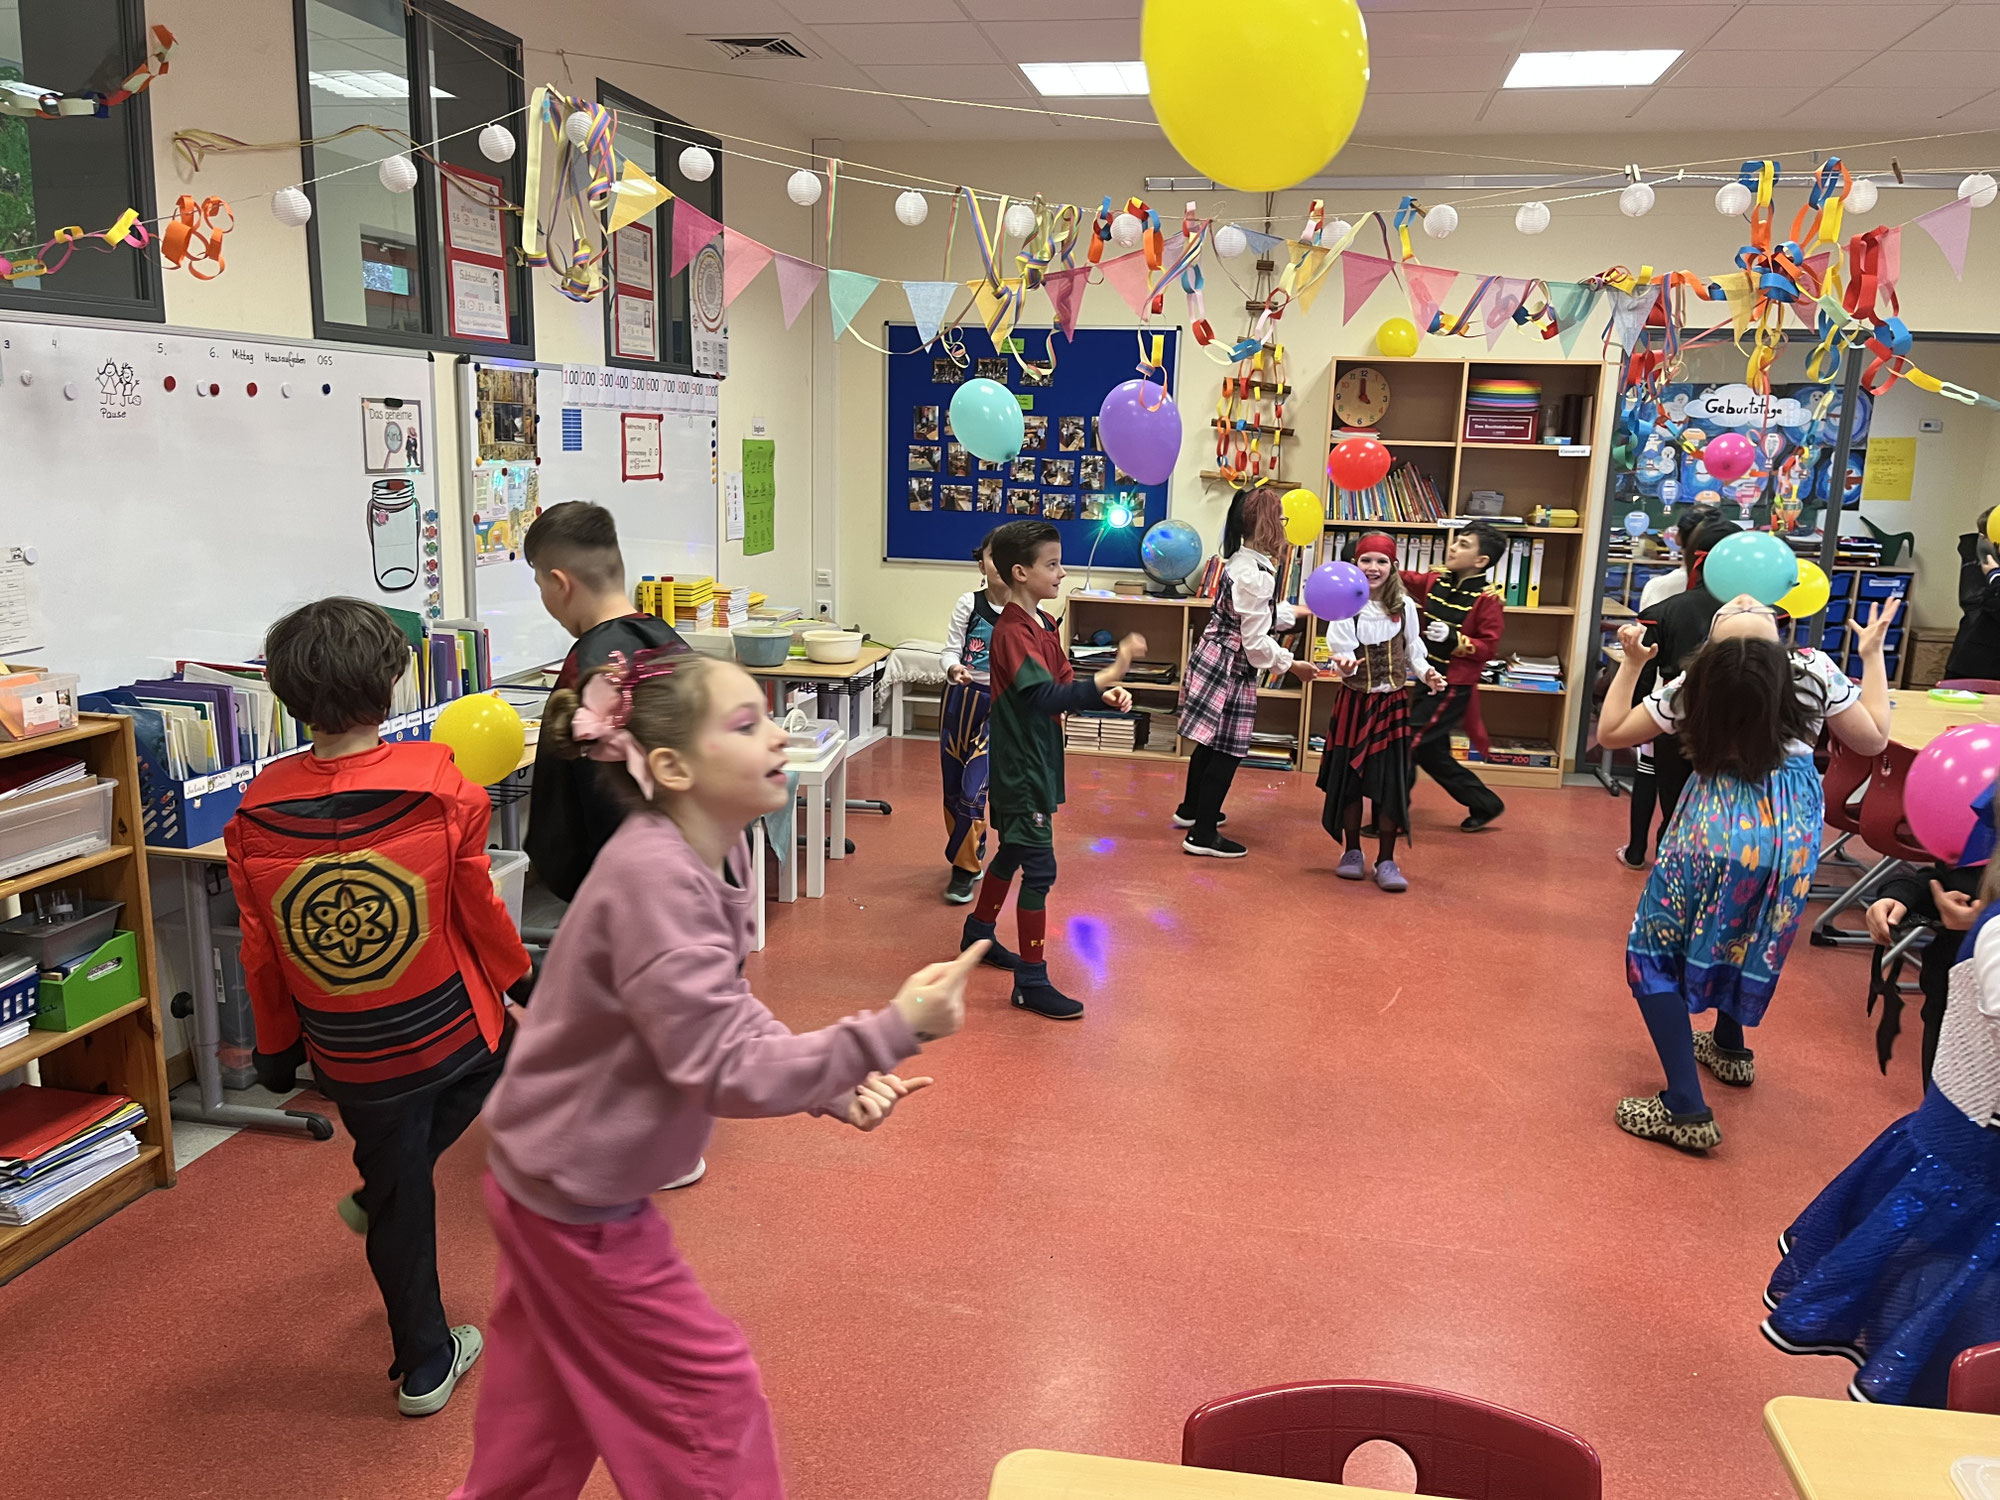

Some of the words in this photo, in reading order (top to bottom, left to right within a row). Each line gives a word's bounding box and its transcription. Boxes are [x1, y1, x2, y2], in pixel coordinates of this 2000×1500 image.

[4, 340, 10, 349] 3
[157, 342, 167, 356] 5.
[209, 347, 219, 358] 6.
[232, 349, 254, 364] Mittag
[265, 352, 306, 367] Hausaufgaben
[317, 355, 333, 366] OGS
[564, 370, 579, 385] 100
[581, 371, 596, 386] 200
[599, 373, 614, 387] 300
[615, 375, 629, 389] 400
[632, 377, 645, 391] 500
[647, 378, 660, 391] 600
[663, 379, 675, 393] 700
[678, 381, 690, 394] 800
[691, 383, 703, 395] 900
[100, 407, 127, 419] Pause
[369, 408, 384, 420] Das
[1512, 755, 1530, 764] 200
[235, 769, 250, 778] Aylin
